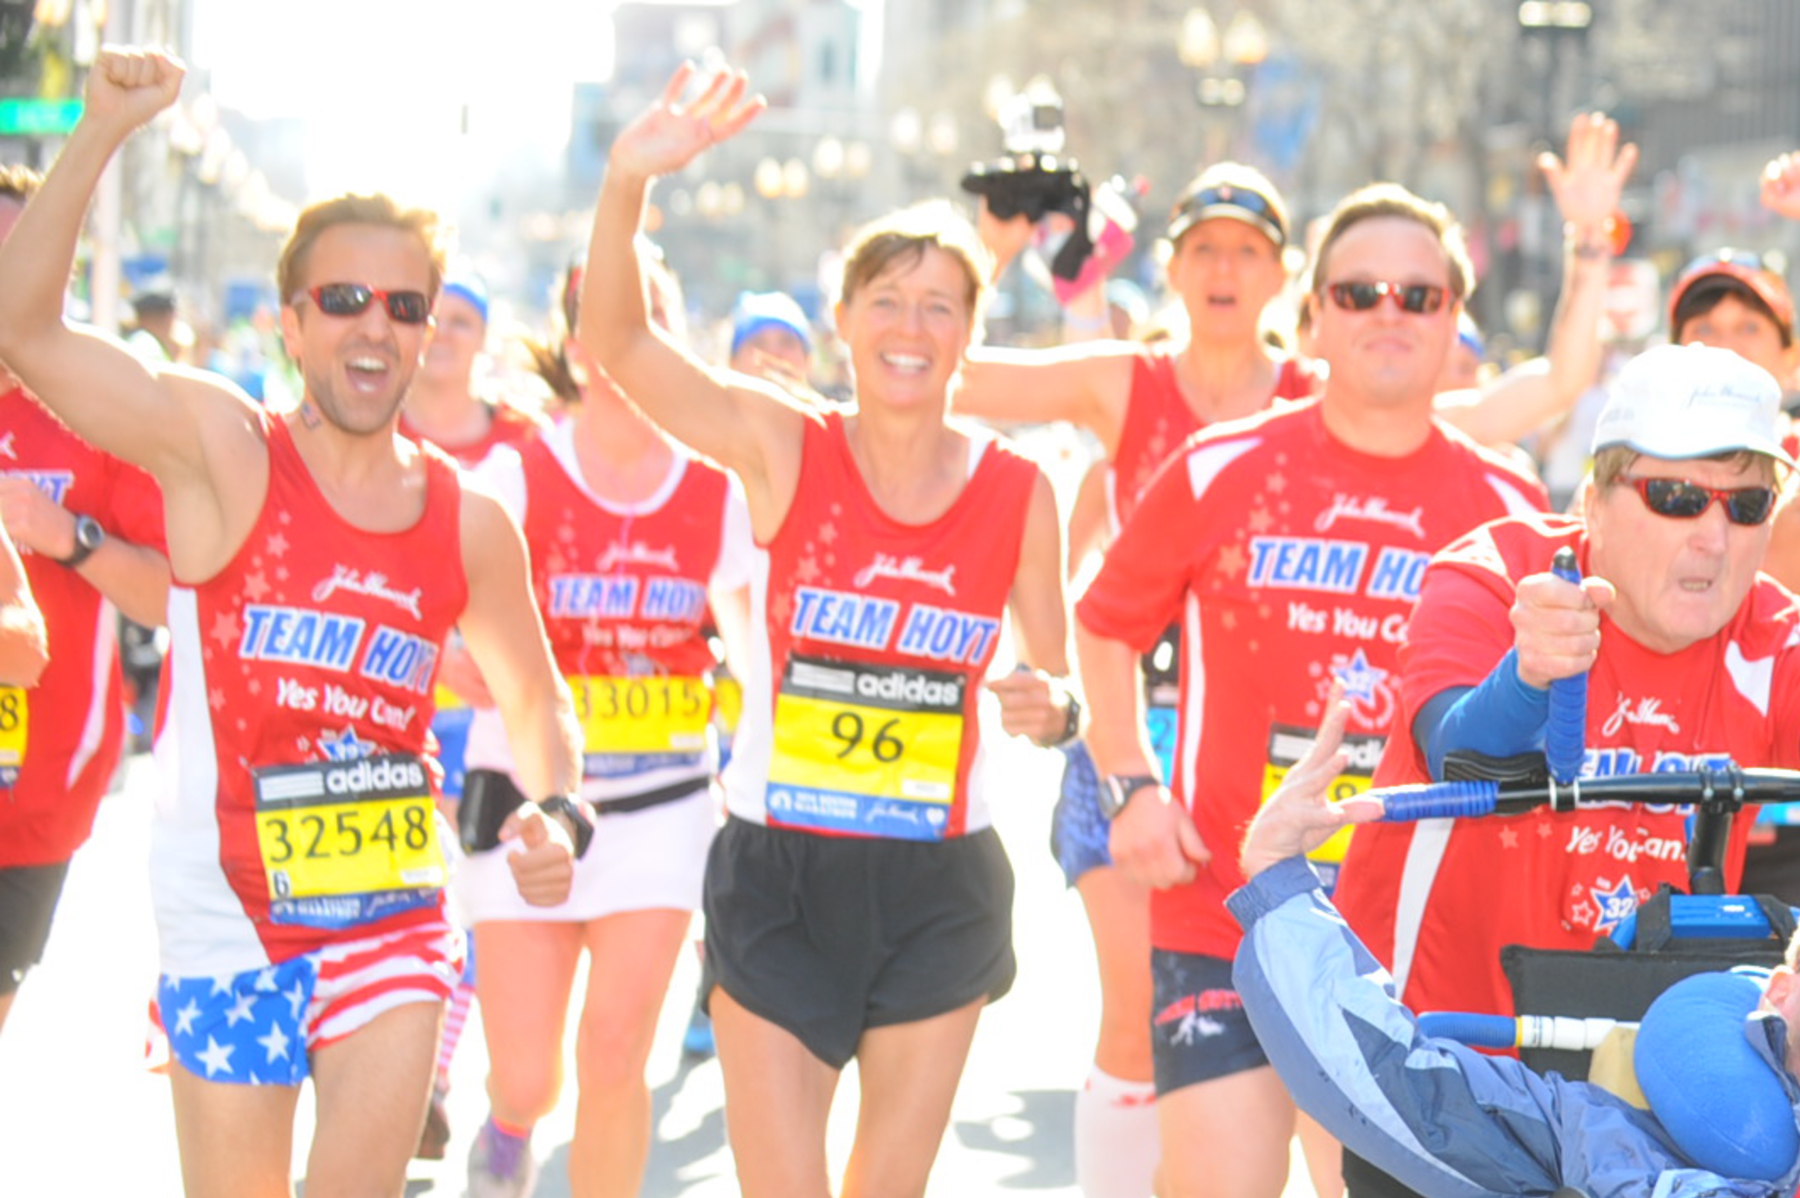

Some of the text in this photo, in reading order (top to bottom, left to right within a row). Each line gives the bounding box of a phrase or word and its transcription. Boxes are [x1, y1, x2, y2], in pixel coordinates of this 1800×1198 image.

[1247, 535, 1369, 595] TEAM
[548, 573, 640, 619] TEAM
[1287, 602, 1328, 633] Yes
[1331, 608, 1379, 639] You
[238, 603, 367, 674] TEAM
[790, 584, 1002, 667] TEAM HOYT
[277, 676, 318, 711] Yes
[323, 683, 369, 720] You
[856, 671, 960, 707] adidas
[832, 711, 905, 764] 96
[326, 758, 425, 794] adidas
[265, 804, 429, 864] 32548
